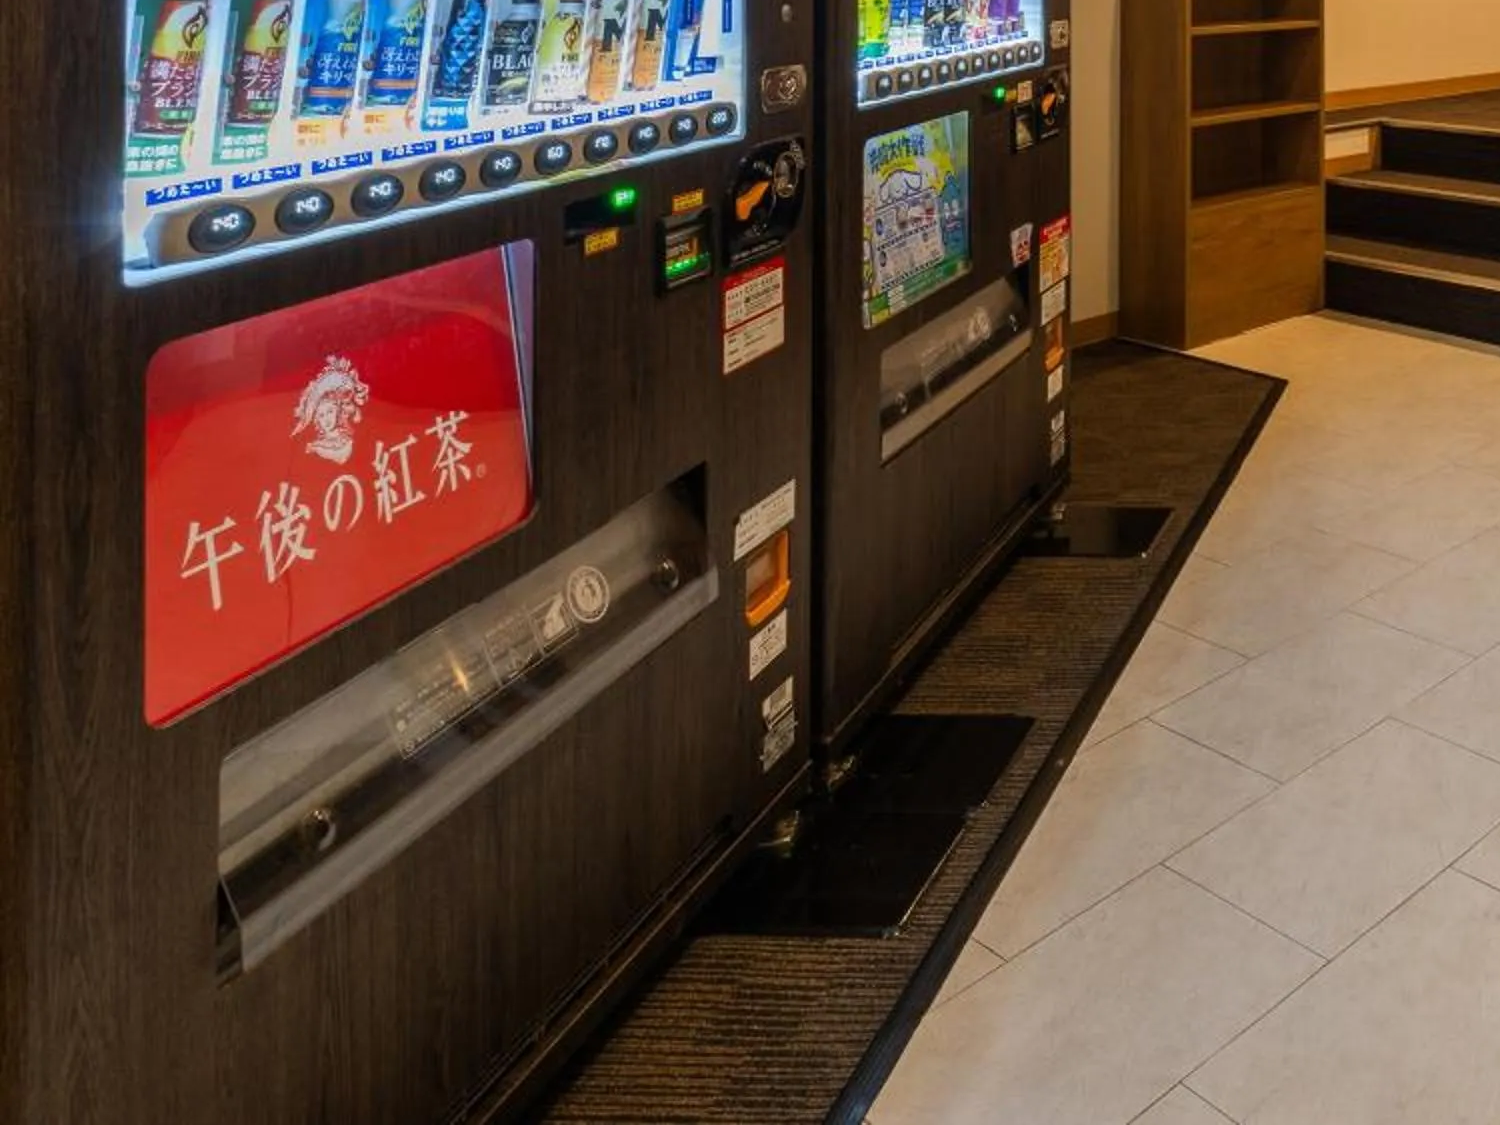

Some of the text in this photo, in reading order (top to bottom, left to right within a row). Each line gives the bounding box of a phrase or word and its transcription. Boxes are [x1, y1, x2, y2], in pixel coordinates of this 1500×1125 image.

[388, 141, 434, 158] つめた〜い
[316, 152, 370, 172] つめた〜い
[240, 166, 299, 185] つめた〜い
[154, 180, 219, 202] つめた〜い
[181, 410, 473, 612] 午後の紅茶
